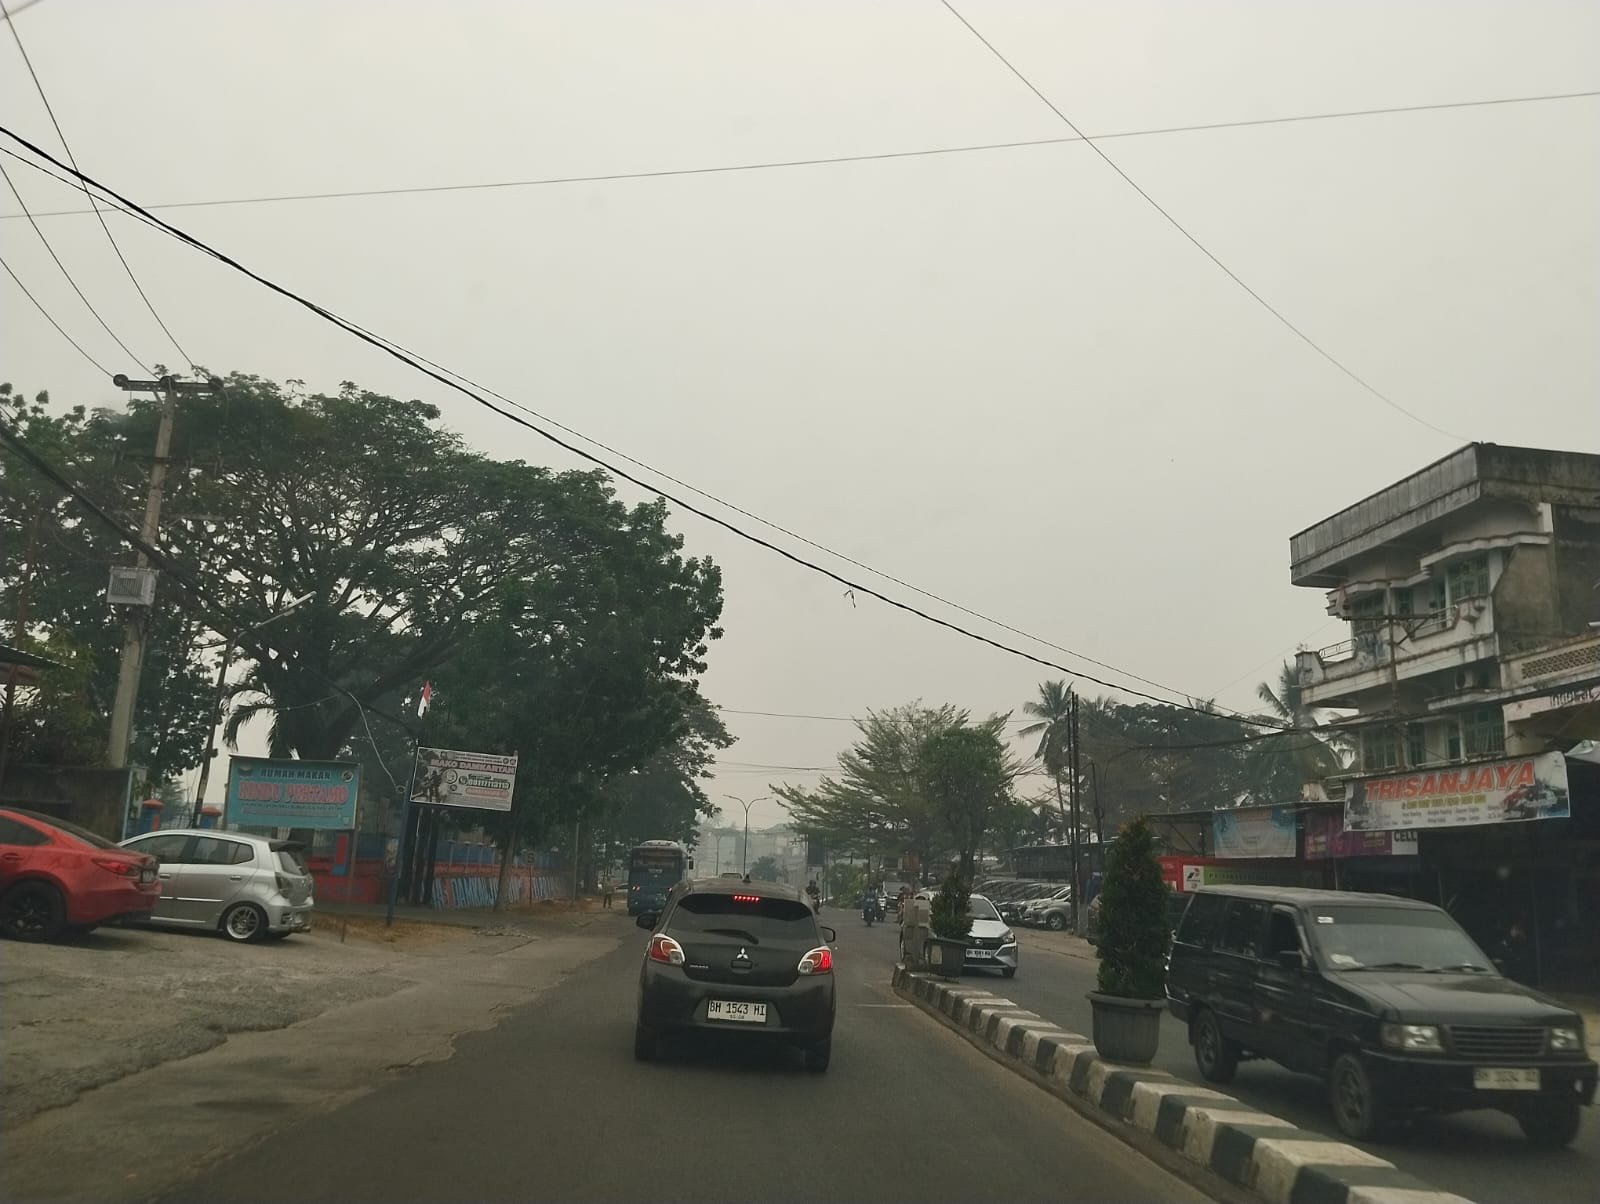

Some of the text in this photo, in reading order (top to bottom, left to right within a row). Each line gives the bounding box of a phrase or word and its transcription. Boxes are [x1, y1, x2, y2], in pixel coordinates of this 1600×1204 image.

[260, 768, 331, 780] RUMAH MAKAN
[430, 759, 515, 774] MAKO DAMKARTAN
[1364, 760, 1536, 802] TRISANJAYA
[1394, 830, 1417, 842] CELL
[710, 1001, 765, 1016] BH 1543 HI
